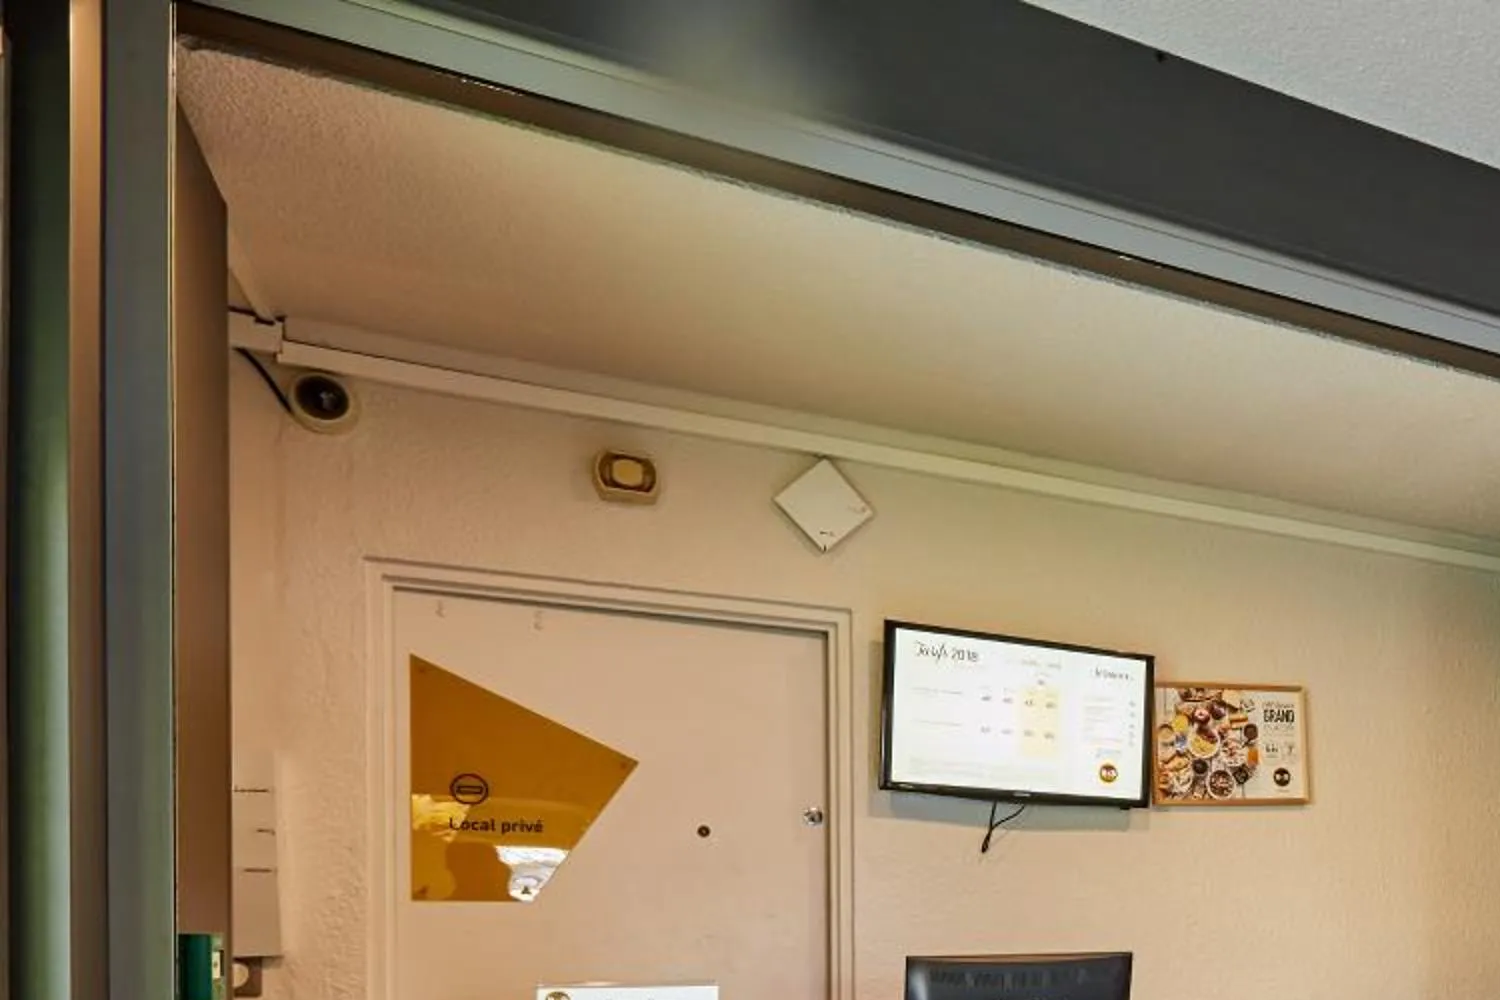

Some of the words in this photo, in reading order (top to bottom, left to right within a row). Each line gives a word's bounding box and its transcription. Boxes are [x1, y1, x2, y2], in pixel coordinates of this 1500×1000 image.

[1263, 709, 1295, 723] GRAND
[449, 817, 496, 832] Local
[501, 818, 544, 835] privé
